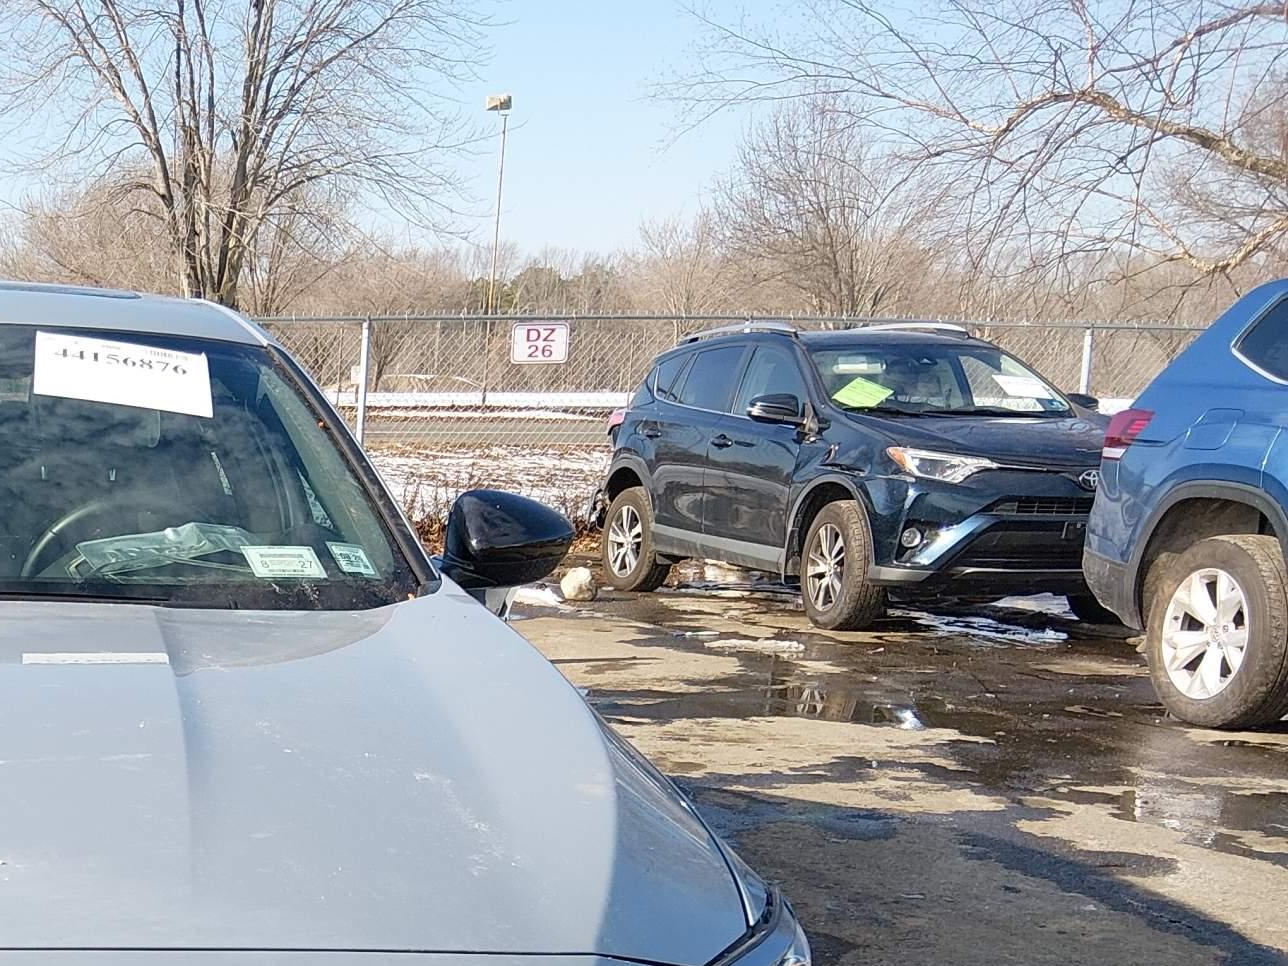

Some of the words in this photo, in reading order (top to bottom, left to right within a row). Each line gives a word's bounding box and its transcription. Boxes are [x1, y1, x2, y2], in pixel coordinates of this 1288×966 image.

[526, 328, 557, 342] DZ
[527, 344, 553, 358] 26
[54, 348, 188, 376] 44156876
